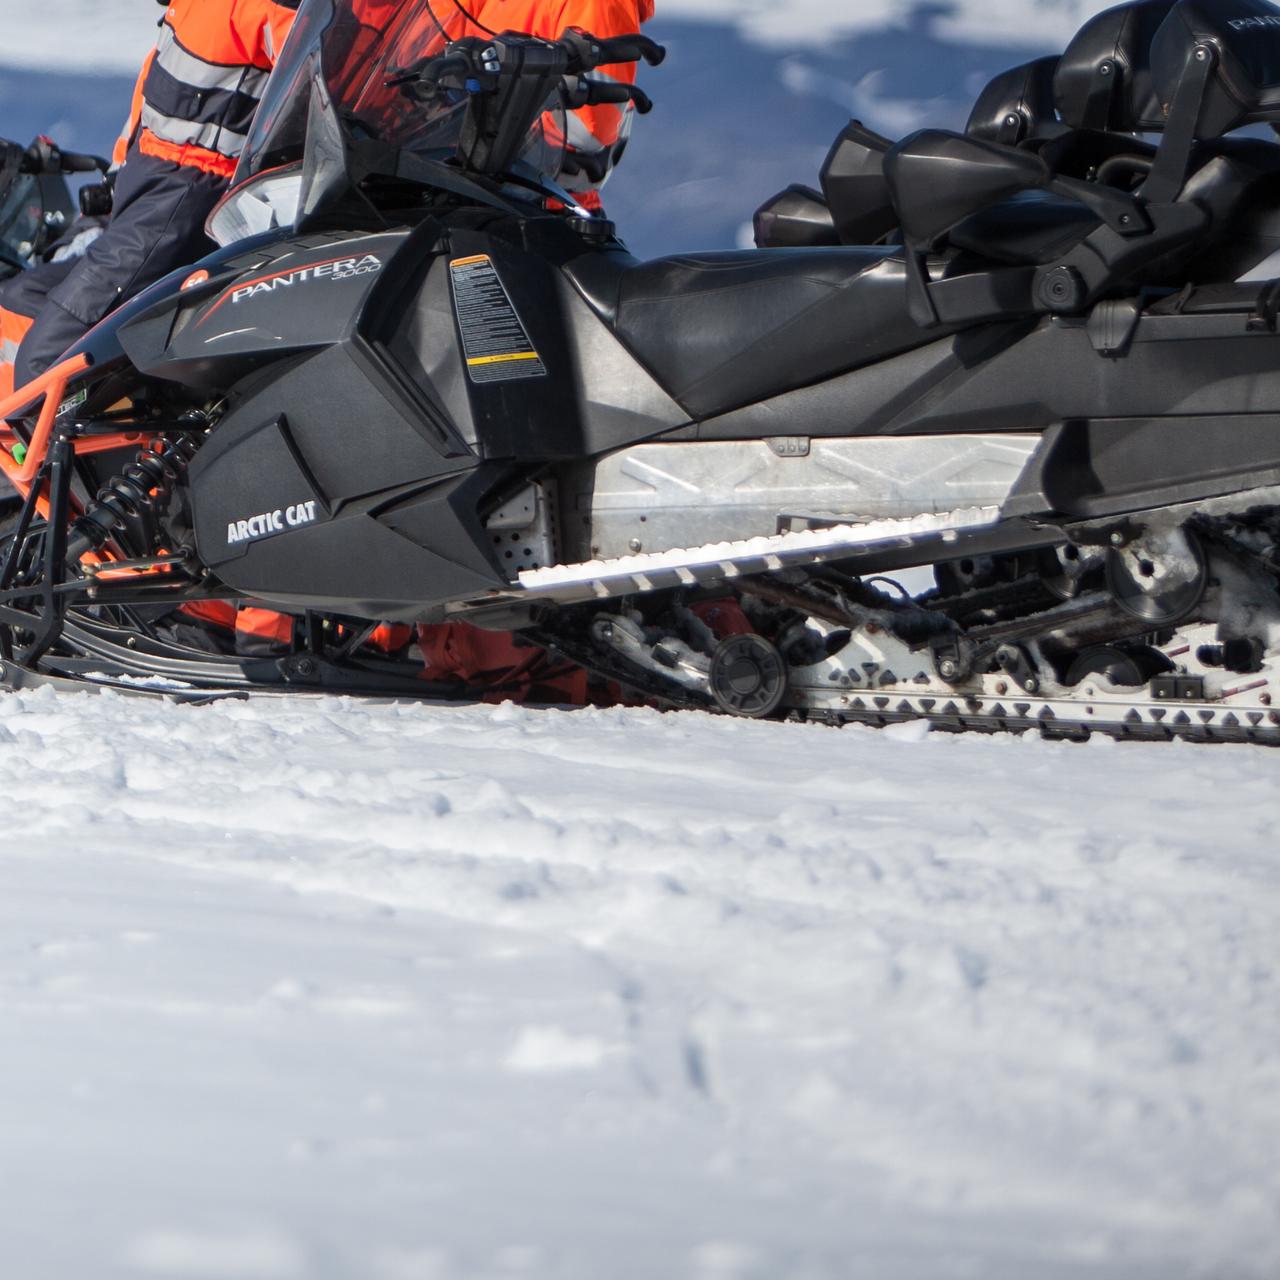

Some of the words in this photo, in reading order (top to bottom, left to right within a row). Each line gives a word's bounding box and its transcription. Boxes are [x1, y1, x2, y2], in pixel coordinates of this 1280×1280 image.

[232, 254, 381, 303] PANTERA
[331, 263, 382, 280] 3000
[227, 509, 283, 544] ARCTIC
[285, 500, 315, 526] CAT
